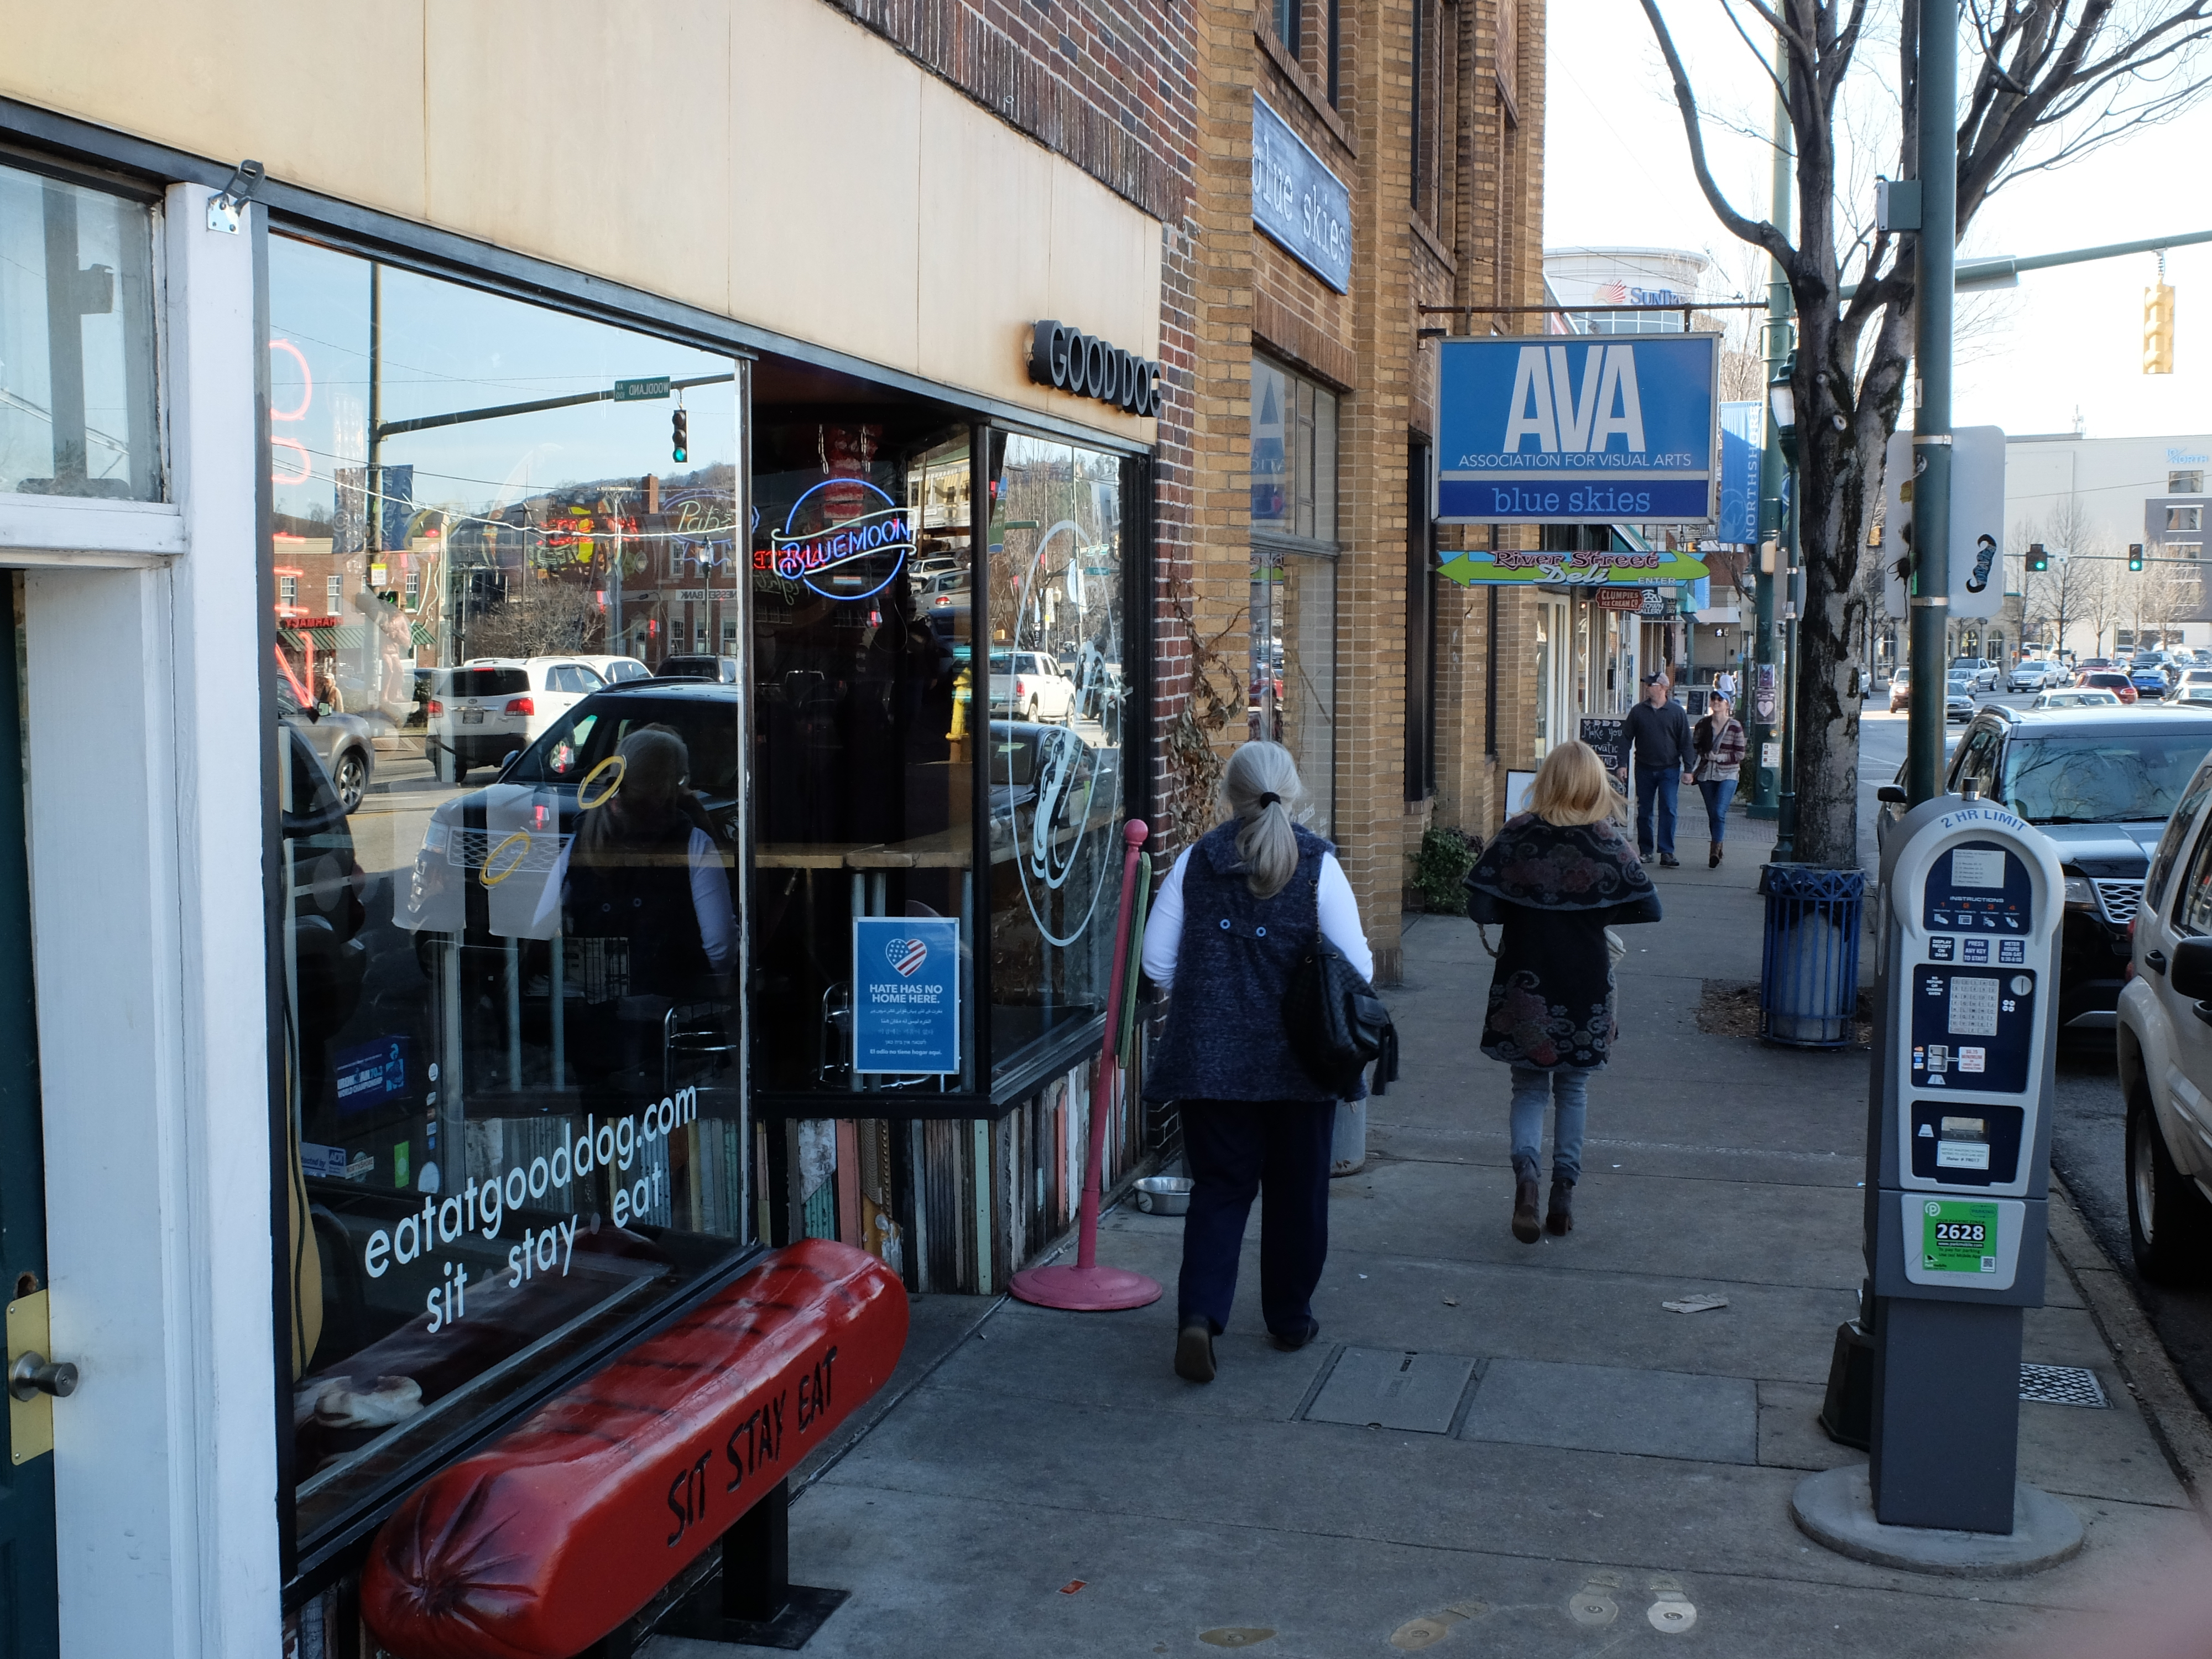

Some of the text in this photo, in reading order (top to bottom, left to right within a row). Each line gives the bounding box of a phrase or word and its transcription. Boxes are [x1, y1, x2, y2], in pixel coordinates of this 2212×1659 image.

[1302, 185, 1347, 269] skies
[1037, 320, 1160, 416] GOOD DOG
[1503, 345, 1646, 453] AVA
[1458, 454, 1691, 467] ASSOCIATION FOR VISUAL ARTS
[2171, 455, 2209, 463] NORTH
[1746, 406, 1760, 540] NORTHSHORE
[1492, 486, 1651, 513] blue skies
[780, 518, 910, 579] BLUE MOON
[1492, 550, 1660, 570] River Street
[1533, 564, 1609, 585] Deli
[1600, 589, 1639, 601] CLUMPIES
[1608, 728, 1622, 742] you
[1941, 810, 2028, 831] 2 HR LIMIT
[870, 984, 943, 994] HATE HAS NO
[872, 994, 940, 1004] HOME HERE.
[364, 1086, 697, 1278] eatatgooddog.com
[1937, 1224, 1984, 1240] 2628
[427, 1161, 662, 1334] sit stay eat
[667, 1345, 837, 1548] SIT STAY EAT
